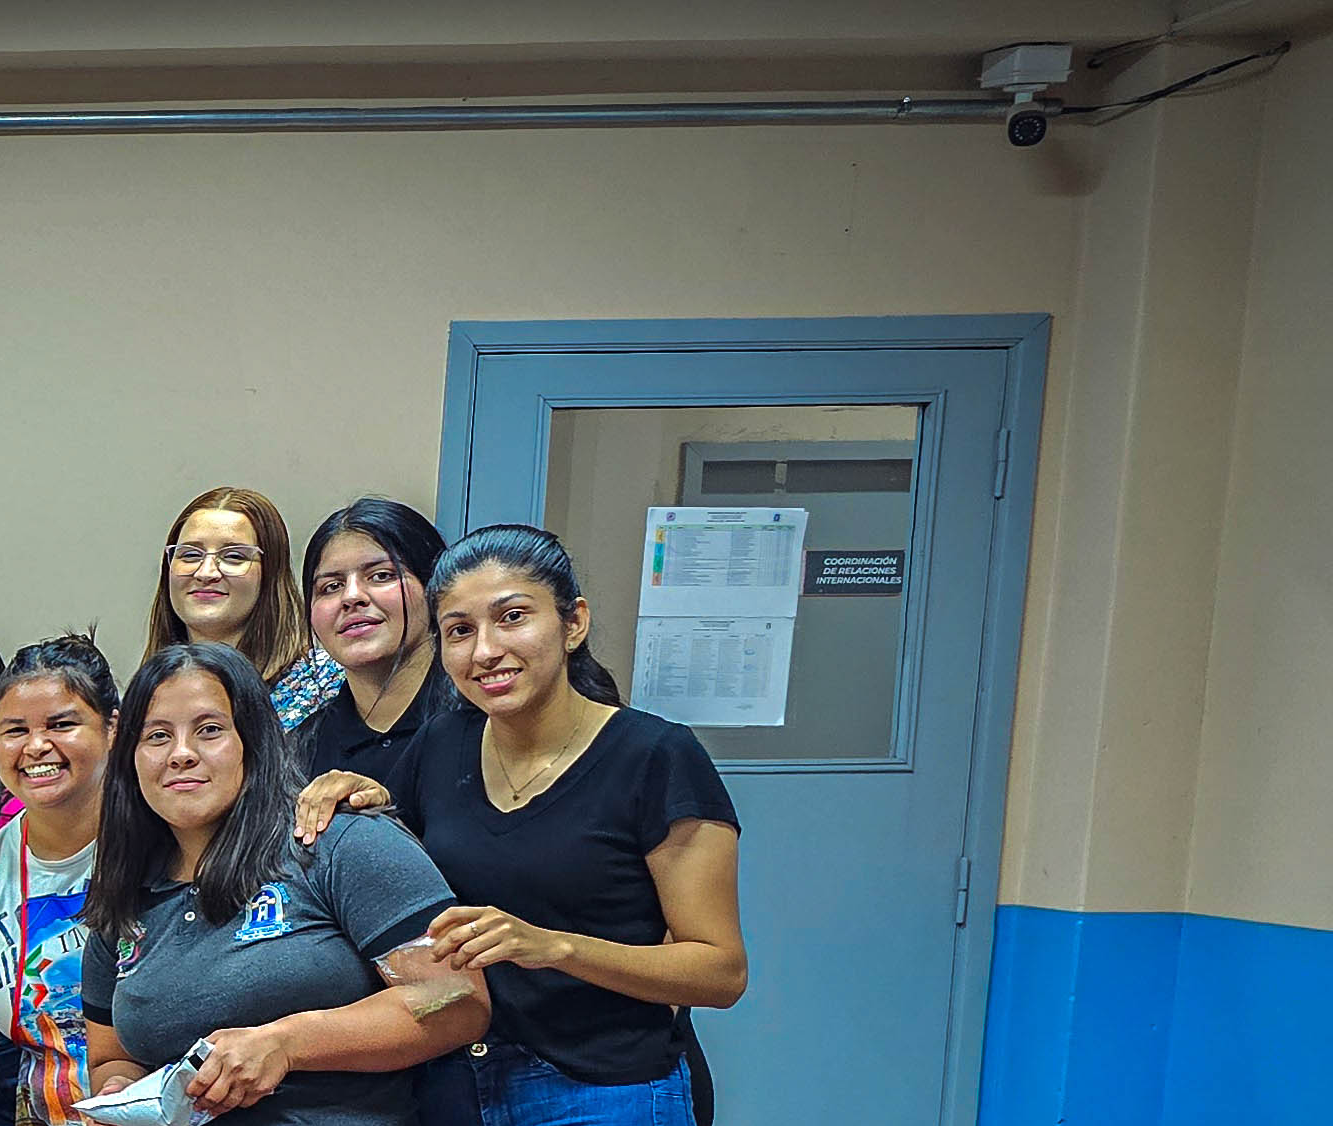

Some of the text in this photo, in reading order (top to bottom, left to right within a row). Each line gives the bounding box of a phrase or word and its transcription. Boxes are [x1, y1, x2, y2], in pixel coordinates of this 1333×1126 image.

[823, 556, 898, 566] COORDINACIÓN
[822, 567, 898, 575] DE RELACIONES
[815, 576, 903, 585] INTERNACIONALES
